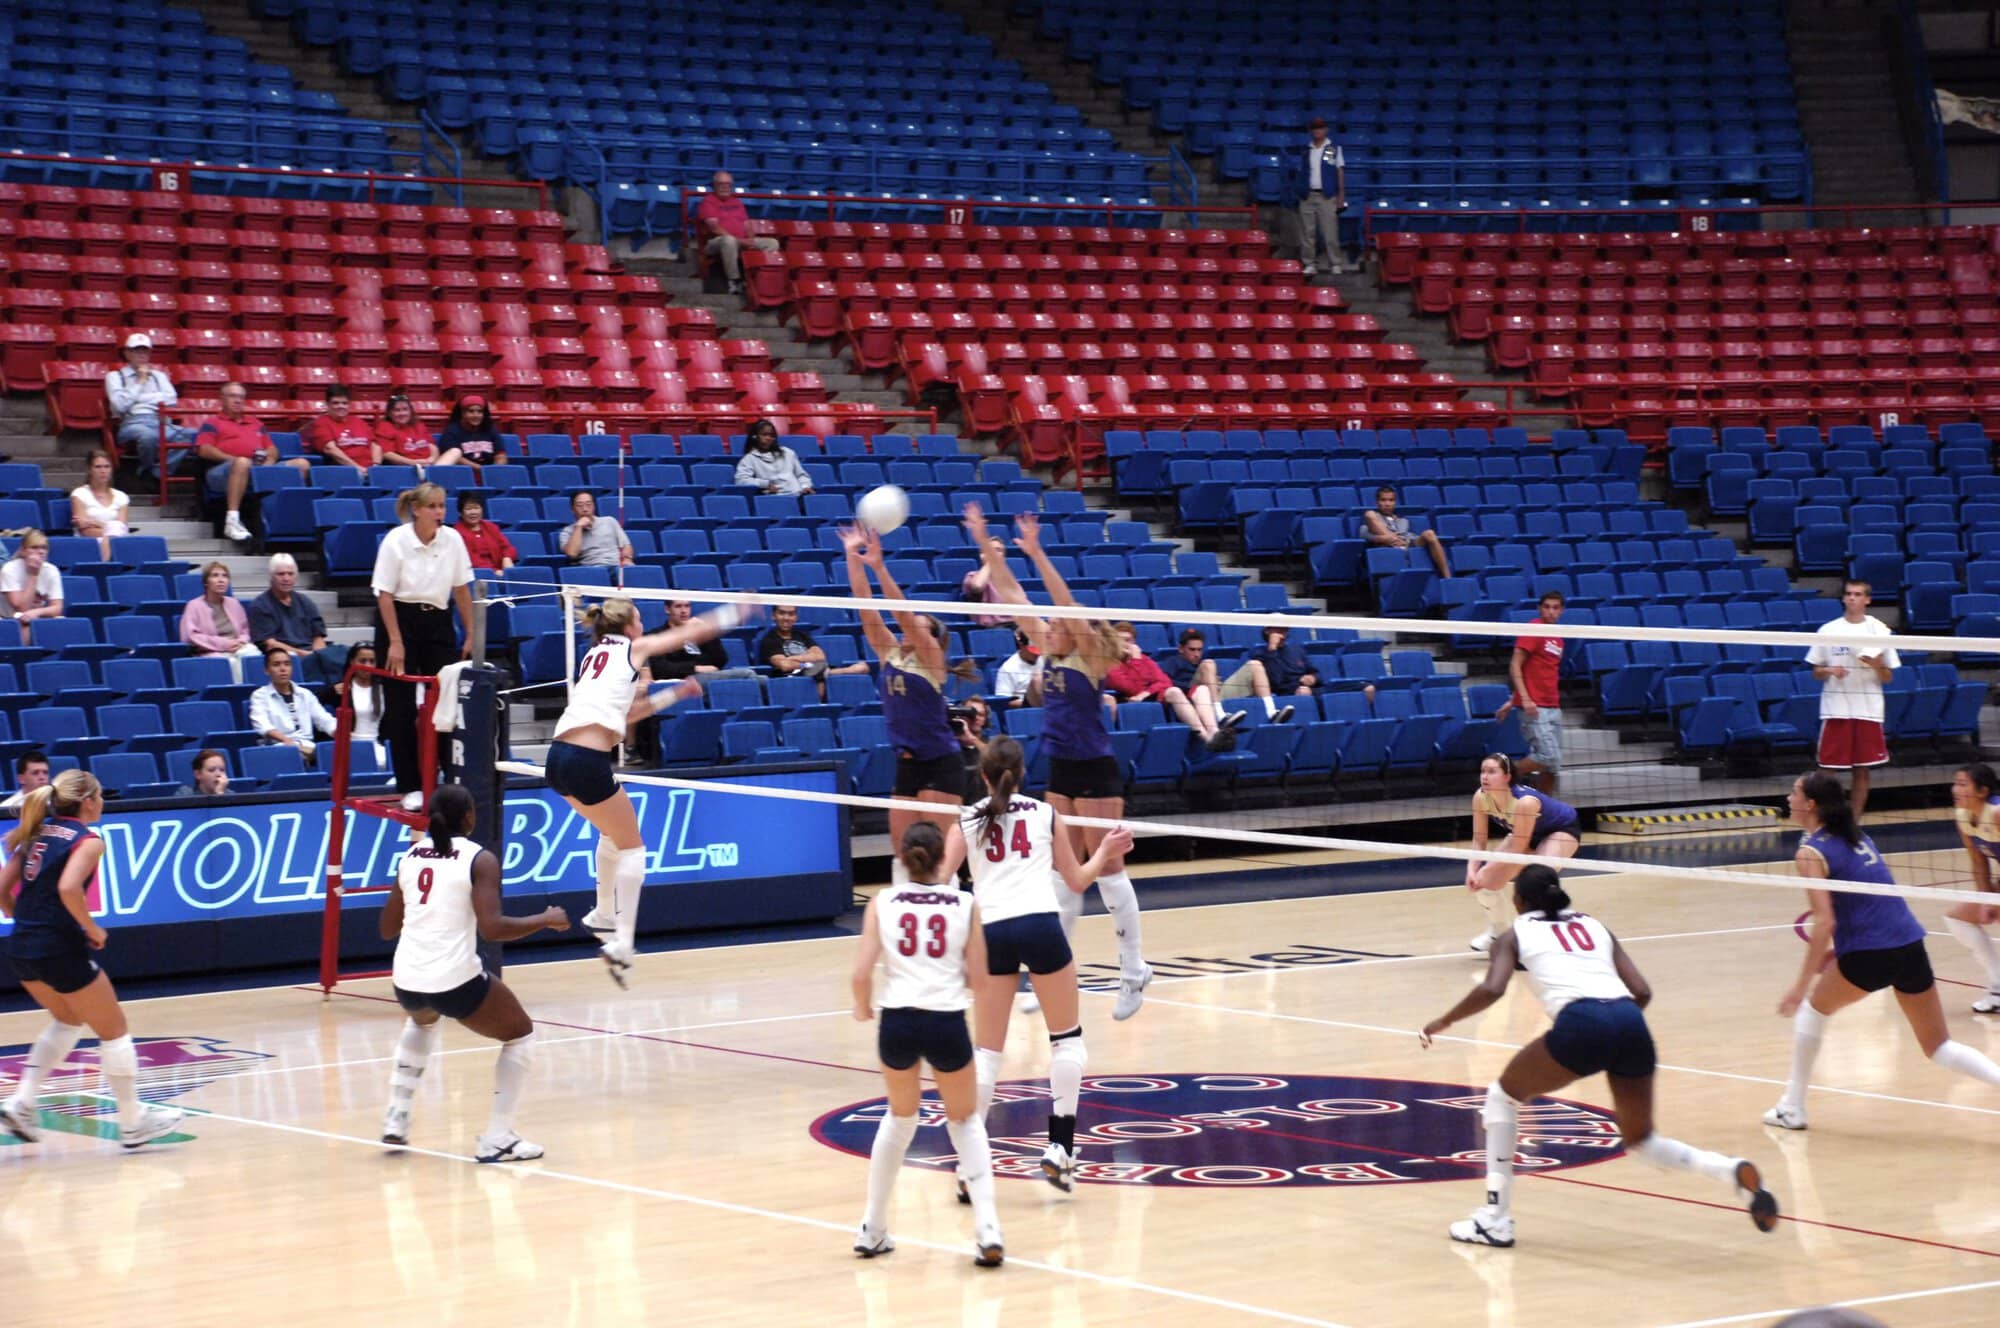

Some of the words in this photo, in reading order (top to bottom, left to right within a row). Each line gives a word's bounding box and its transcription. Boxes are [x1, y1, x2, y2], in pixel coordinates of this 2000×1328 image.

[159, 172, 178, 191] 16
[950, 209, 965, 225] 17
[1692, 216, 1708, 231] 18
[585, 420, 607, 435] 16
[1880, 412, 1899, 428] 18
[886, 675, 907, 697] 14
[100, 789, 706, 915] VOLLEBAL
[707, 843, 738, 867] TM
[986, 819, 1032, 863] 34
[417, 867, 434, 905] 9
[898, 912, 947, 959] 33
[1551, 922, 1595, 953] 10
